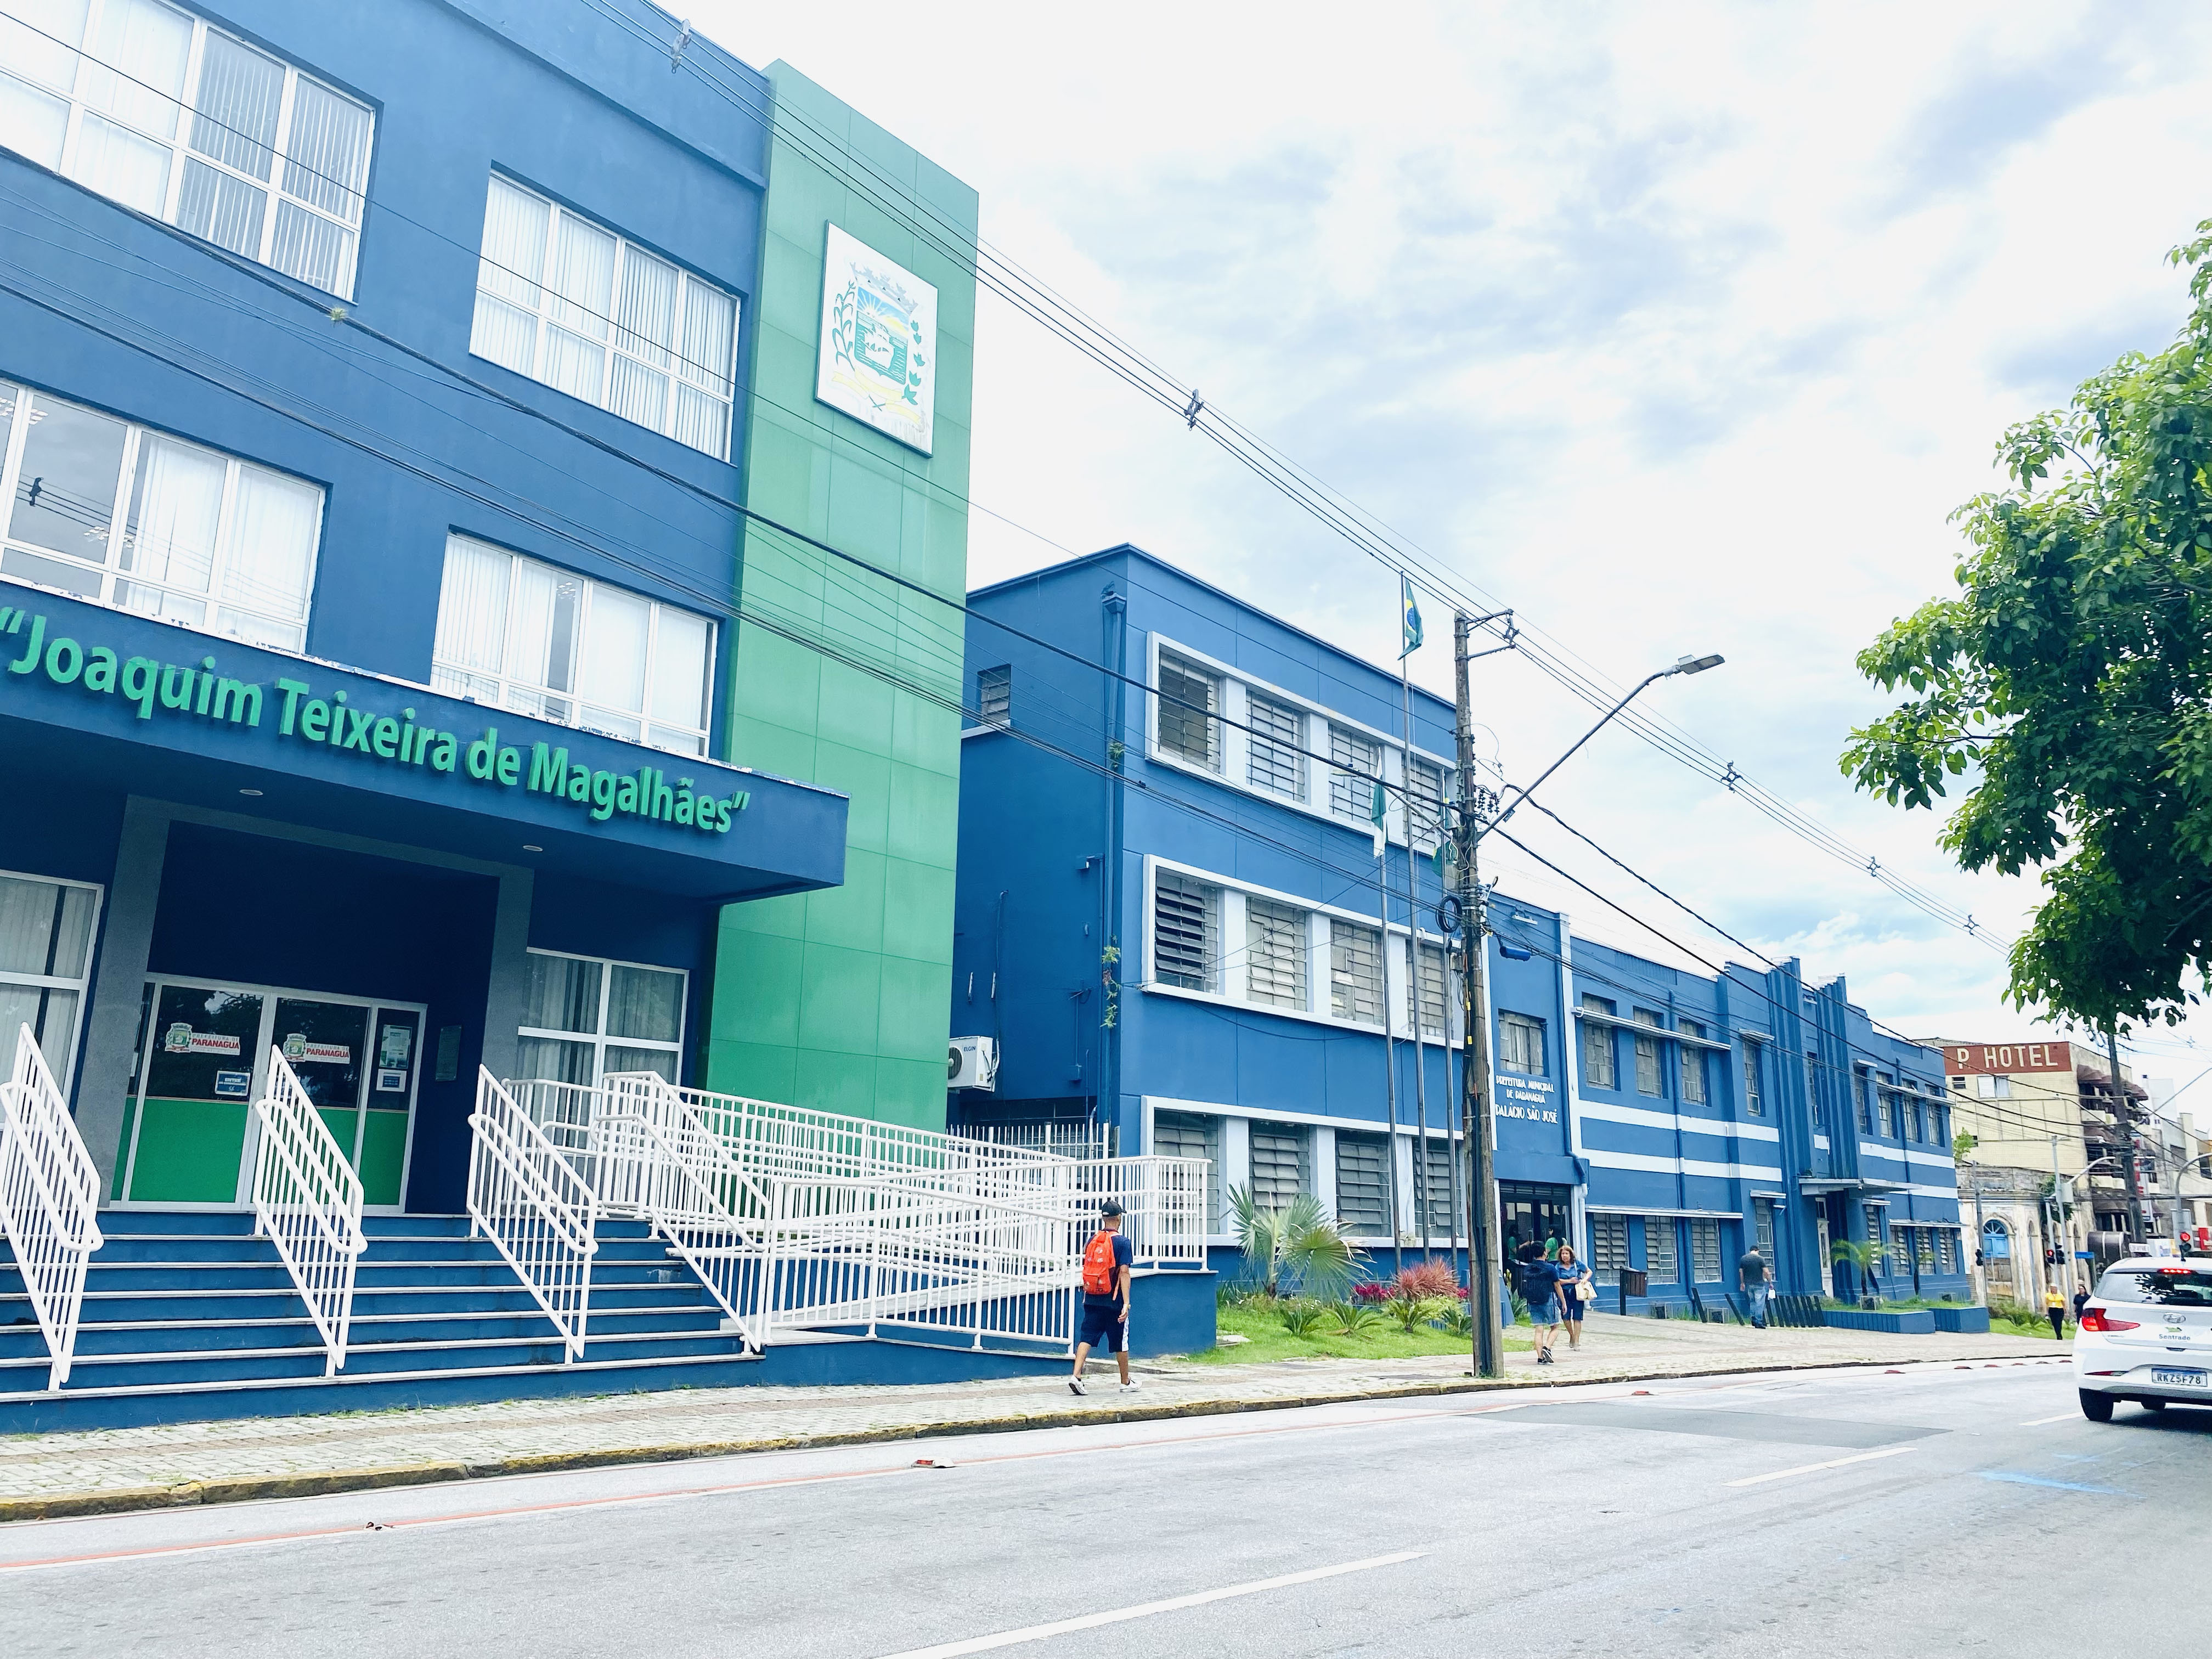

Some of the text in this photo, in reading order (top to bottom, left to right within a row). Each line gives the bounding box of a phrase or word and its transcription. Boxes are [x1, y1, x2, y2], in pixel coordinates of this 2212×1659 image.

[275, 678, 457, 772] Teixeira
[466, 727, 521, 786] de
[1983, 1045, 2058, 1068] HOTEL
[1496, 1075, 1555, 1093] PREFEITURA MUNICIPAL
[1506, 1088, 1546, 1104] DE PARANAGUÁ
[1495, 1102, 1558, 1124] PALÁCIO SÃO JOSÉ
[2157, 1373, 2201, 1384] RKZ5F78
